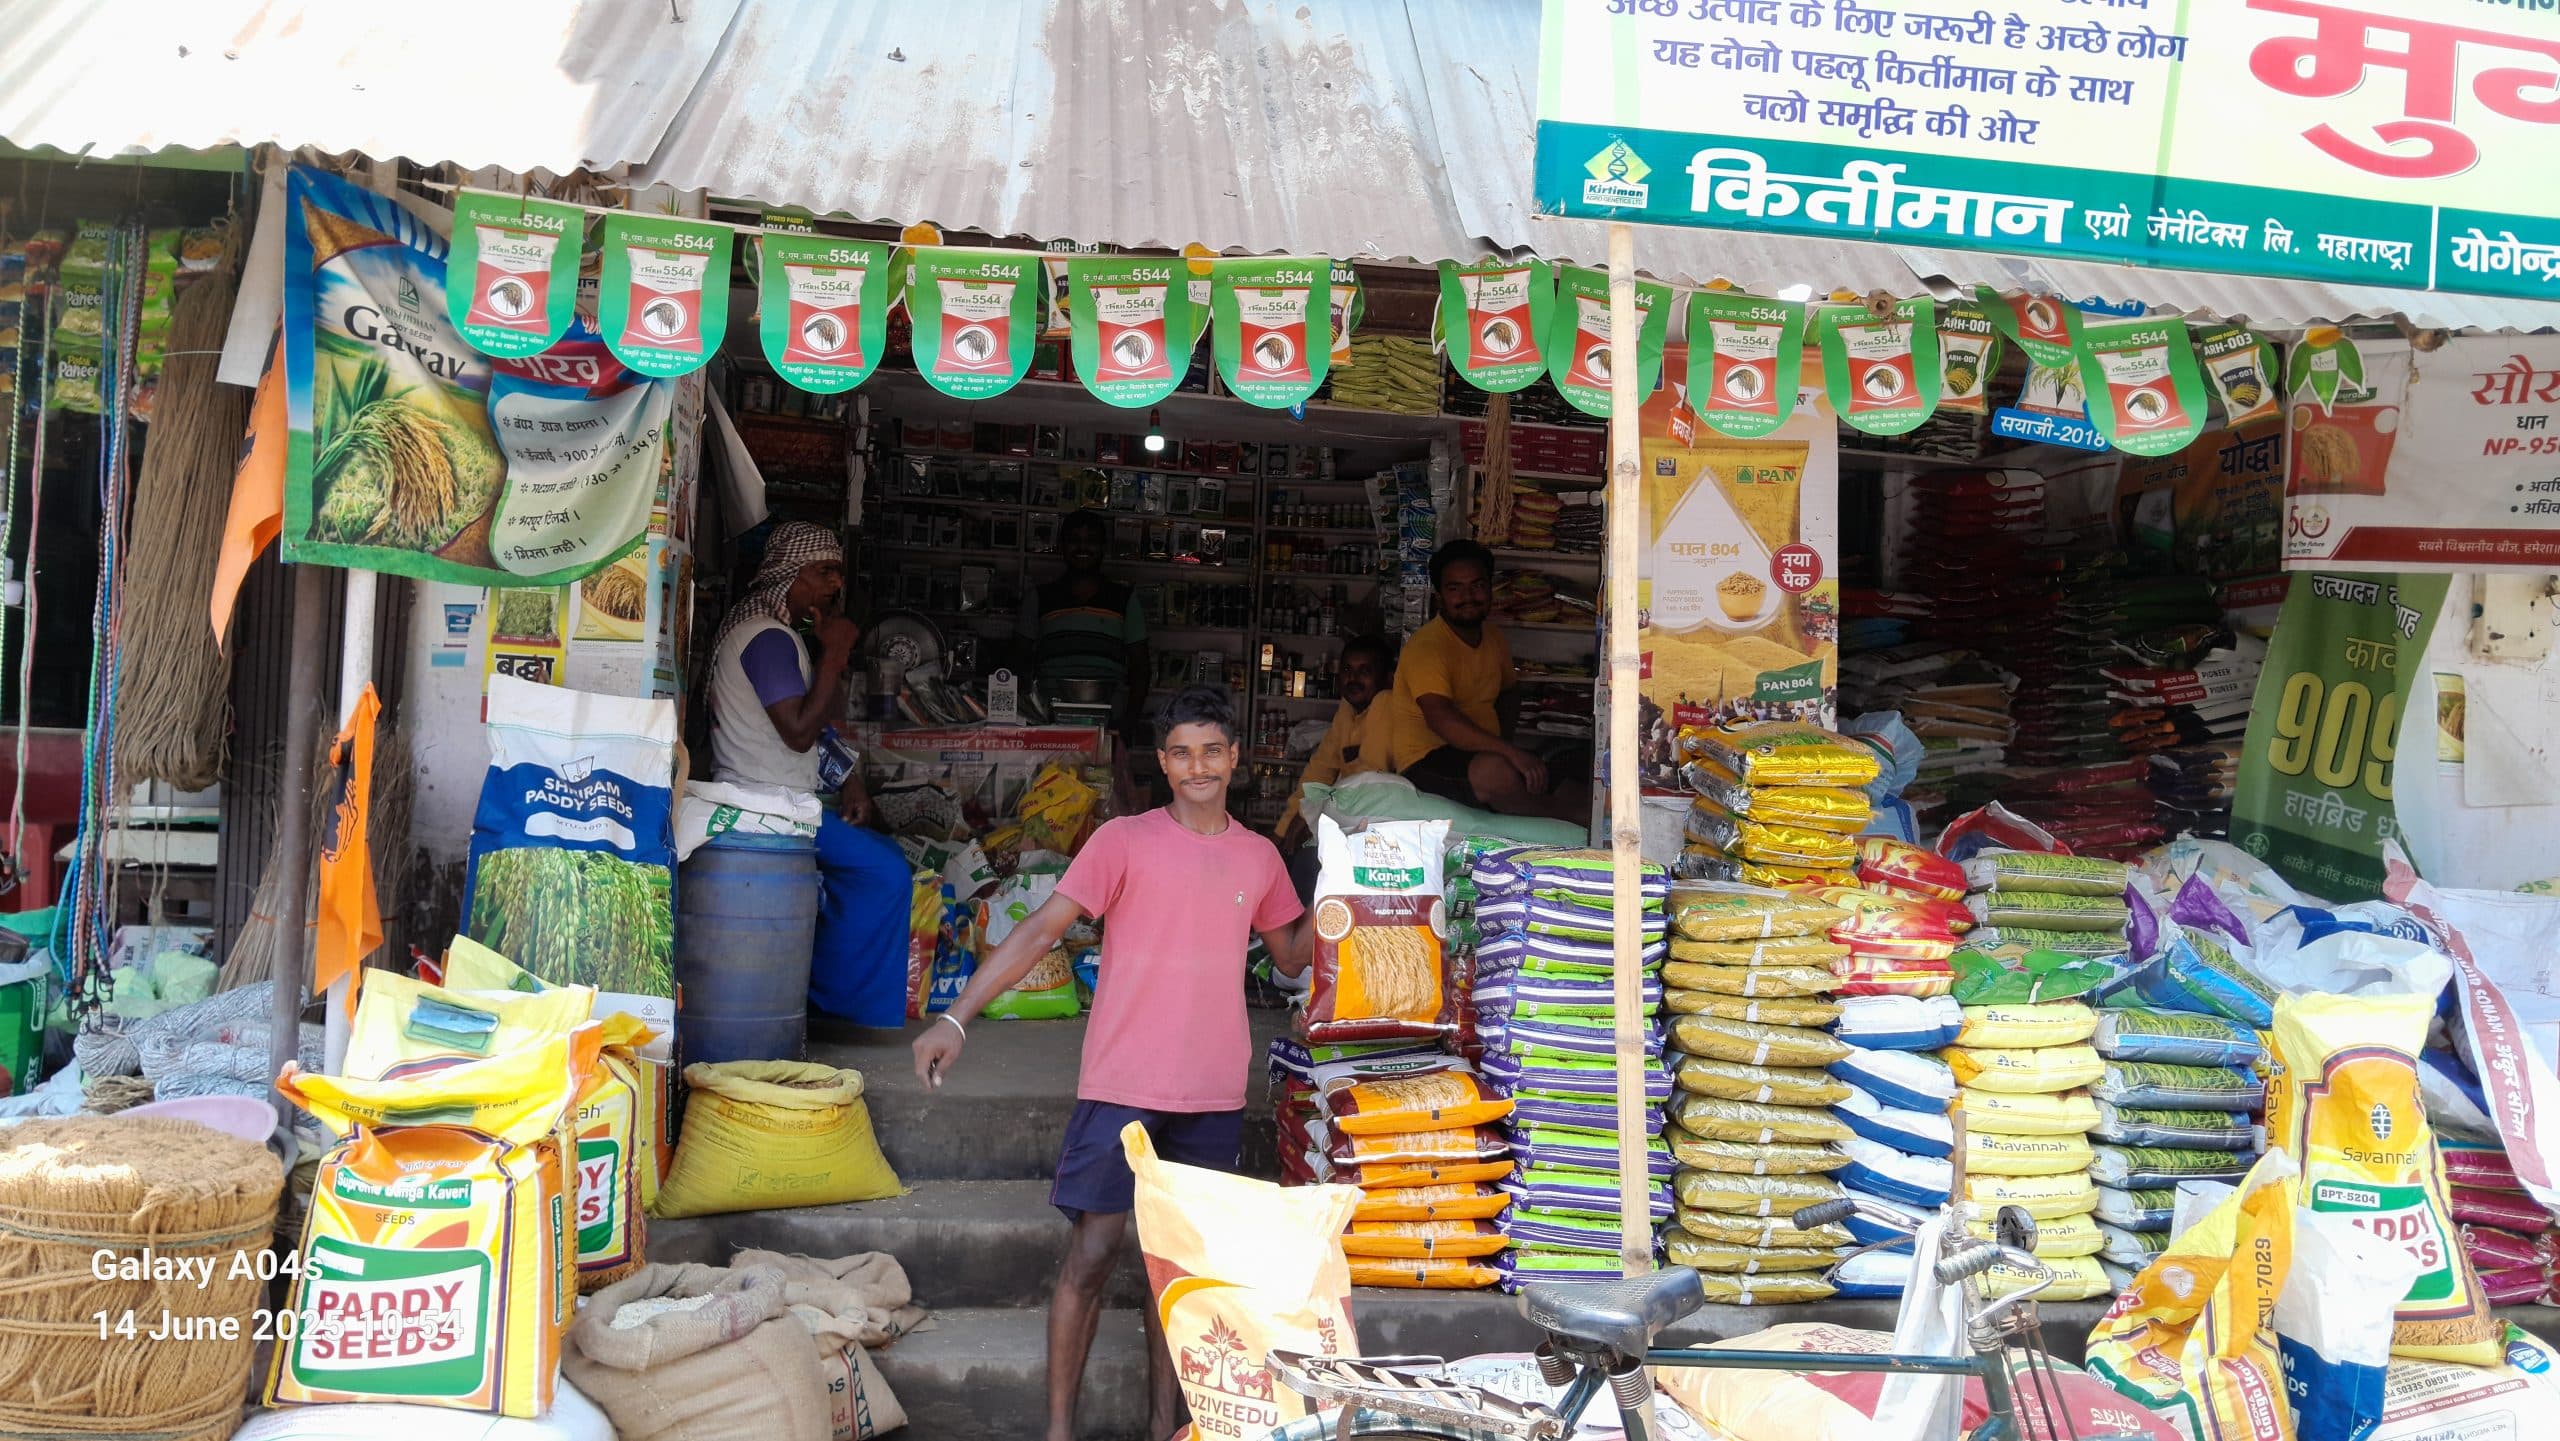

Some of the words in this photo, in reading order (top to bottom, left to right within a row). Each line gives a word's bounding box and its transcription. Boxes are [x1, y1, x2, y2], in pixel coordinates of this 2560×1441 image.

[1789, 0, 1826, 29] के
[1834, 0, 1895, 37] लिए
[1903, 5, 1995, 47] जरूरी
[2003, 13, 2032, 49] है
[2036, 20, 2112, 54] अच्छे
[2117, 24, 2188, 62] लोग
[1653, 39, 1704, 68] यह
[1711, 37, 1782, 73] दोनो
[1791, 50, 1868, 91] पहलू
[1876, 50, 2014, 98] किर्तीमान
[2025, 65, 2061, 98] के
[2069, 75, 2134, 105] साथ
[1743, 89, 1810, 124] चलो
[1818, 97, 1914, 138] समृद्धि
[1926, 104, 1970, 140] की
[1977, 109, 2040, 146] ओर
[1588, 183, 1644, 198] Kirtiman
[1686, 147, 2074, 243] किर्तीमान
[2084, 203, 2131, 239] एग्रो
[2146, 206, 2248, 249] जेनेटिक्स
[2263, 220, 2301, 256] लि.
[2317, 232, 2413, 271] महाराष्ट्रा
[522, 212, 565, 232] 5544
[672, 234, 715, 251] 5544
[511, 244, 544, 258] 5544
[829, 249, 871, 265] 5544
[663, 265, 694, 278] 5544
[981, 264, 1021, 279] 5544
[1132, 268, 1172, 282] 5544
[1275, 270, 1314, 284] 5544
[821, 280, 851, 292] 5544
[1492, 285, 1519, 297] 5544
[972, 293, 1003, 306] 5544
[1126, 297, 1155, 310] 5544
[1269, 300, 1298, 312] 5544
[1750, 307, 1788, 323] 5544
[1943, 315, 1991, 335] ARH-001
[1742, 335, 1770, 347] 5544
[1874, 333, 1902, 347] 5544
[2131, 329, 2169, 346] 5544
[2203, 332, 2254, 357] ARH-003
[2131, 357, 2160, 371] 5544
[2516, 414, 2549, 431] धान
[2219, 431, 2281, 476] योद्धा
[1758, 468, 1797, 482] PAN
[1668, 542, 1708, 556] पान
[1710, 543, 1740, 557] 804
[2418, 539, 2444, 552] सबसे
[1781, 551, 1812, 570] नया
[1782, 570, 1811, 588] पैक
[2312, 574, 2380, 606] उत्पादन
[2201, 667, 2231, 679] PIONEER
[1762, 678, 1790, 692] PAN
[1791, 676, 1813, 689] 804
[2209, 682, 2238, 694] PIONEER
[1003, 739, 1028, 749] LTD.
[543, 776, 622, 798] SHRIRAM
[524, 789, 585, 812] PADDY
[589, 795, 634, 819] SEEDS
[2283, 788, 2368, 832] हाइब्रिड
[1368, 869, 1411, 883] Kanak
[2474, 988, 2505, 1034] SONAM
[2491, 1040, 2521, 1090] अंकुर
[427, 1181, 471, 1200] Kaveri
[2320, 1188, 2377, 1204] BPT-5204
[375, 1213, 416, 1226] SEEDS
[317, 1280, 464, 1321] PADDY
[311, 1321, 457, 1361] SEEDS
[2397, 1381, 2424, 1396] SEEDS
[2426, 1374, 2450, 1388] AGRO
[1198, 1413, 1242, 1439] SEEDS
